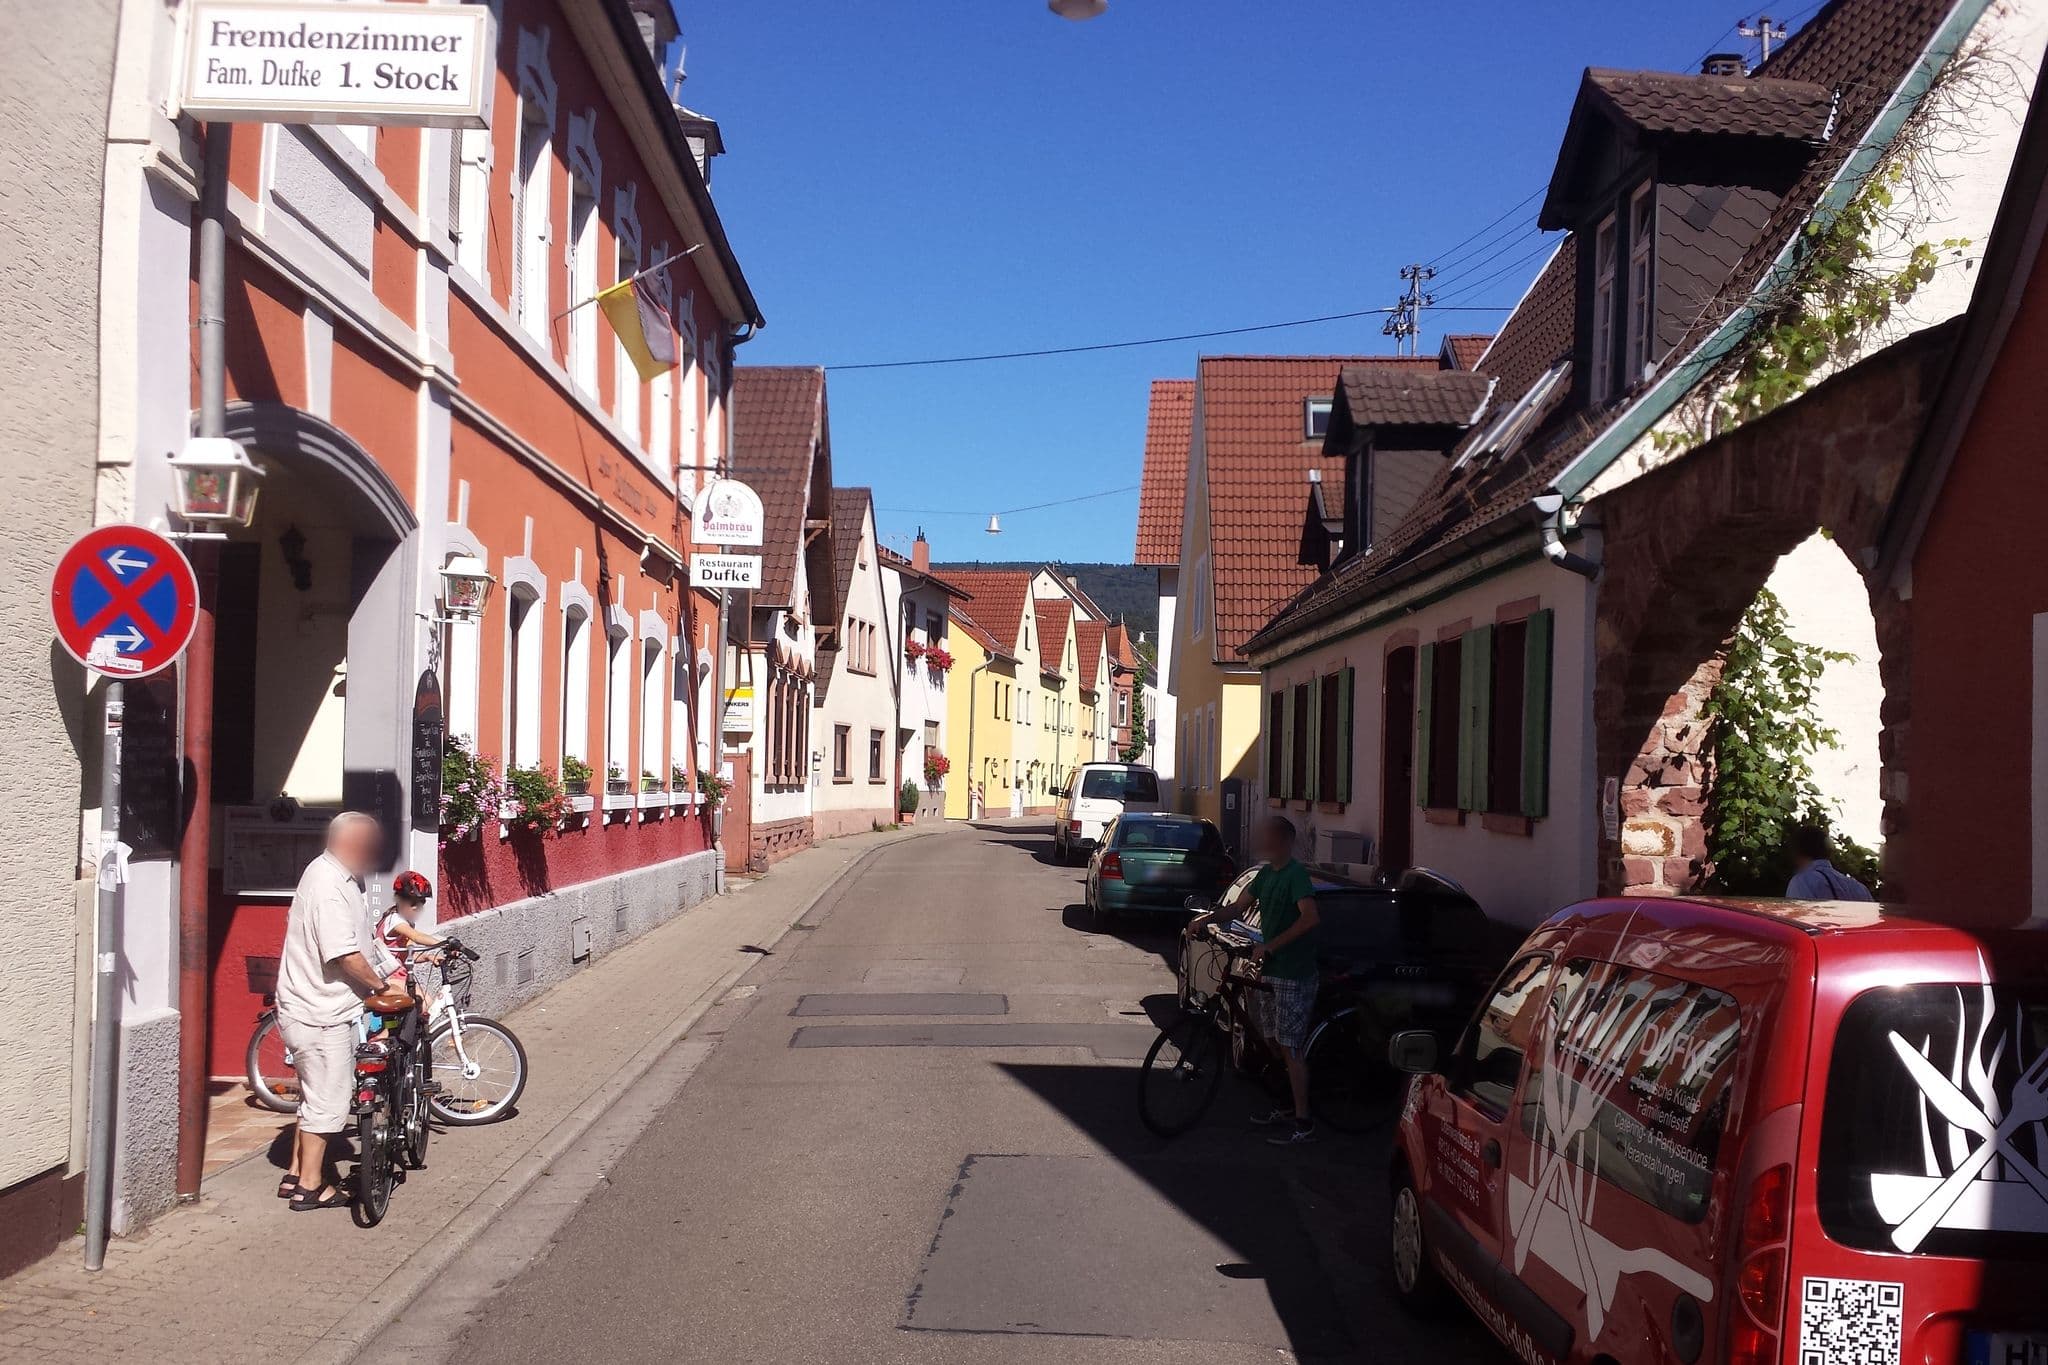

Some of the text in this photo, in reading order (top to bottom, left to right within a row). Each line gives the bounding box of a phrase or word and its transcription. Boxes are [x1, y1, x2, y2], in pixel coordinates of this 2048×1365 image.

[210, 21, 462, 53] Fremdenzimmer
[206, 58, 459, 91] Fam. Dufke 1. Stock
[699, 559, 753, 569] Restaurant
[702, 569, 750, 582] Dufke
[1639, 1022, 1721, 1079] DUFKE
[1637, 1098, 1691, 1134] Familienfeste
[1624, 1140, 1686, 1185] Veranstaltungen
[1656, 1131, 1708, 1169] Partyservice
